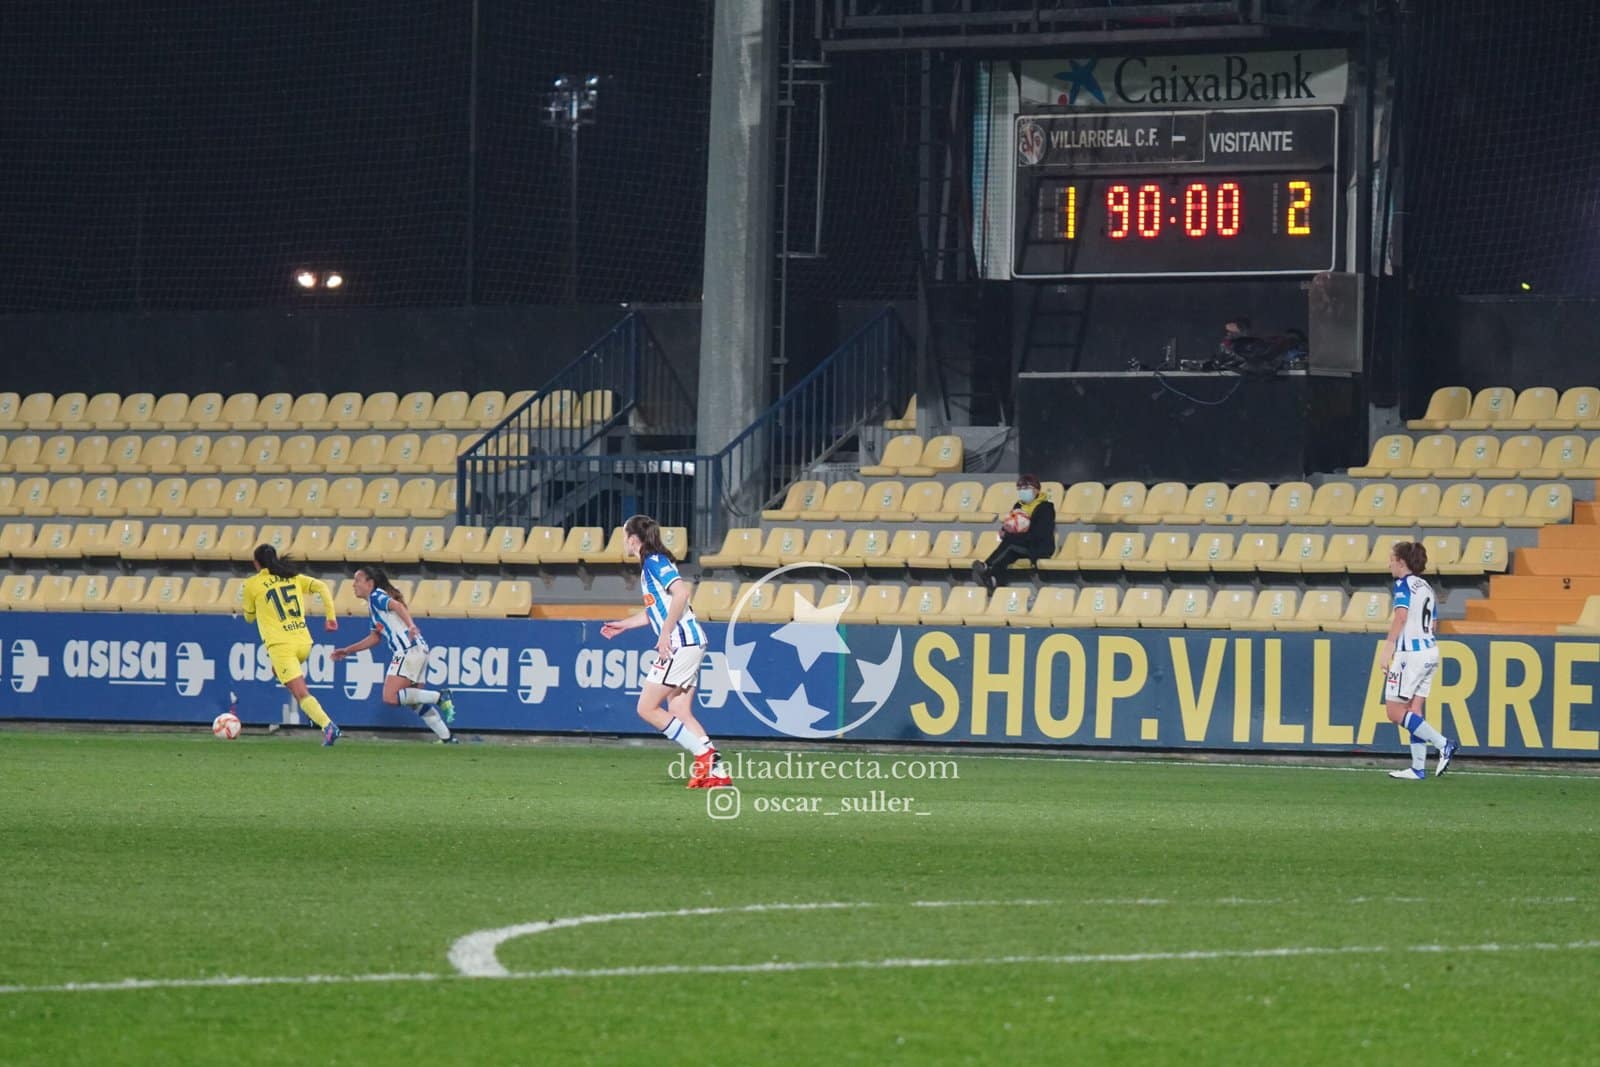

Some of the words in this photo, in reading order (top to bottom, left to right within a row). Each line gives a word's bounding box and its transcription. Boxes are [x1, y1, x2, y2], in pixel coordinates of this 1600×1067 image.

[1113, 55, 1316, 104] CaixaBank
[1049, 128, 1131, 148] VILLARREAL
[1136, 127, 1159, 147] C.F.
[1209, 130, 1293, 153] VISITANTE
[1065, 185, 1076, 239] 1
[1107, 183, 1240, 239] 90:00
[1287, 181, 1312, 235] 2
[265, 584, 302, 622] 15
[1422, 597, 1432, 633] 6
[63, 639, 167, 679] asisa
[229, 642, 335, 682] asa
[423, 646, 509, 687] sisa
[575, 648, 656, 689] asis
